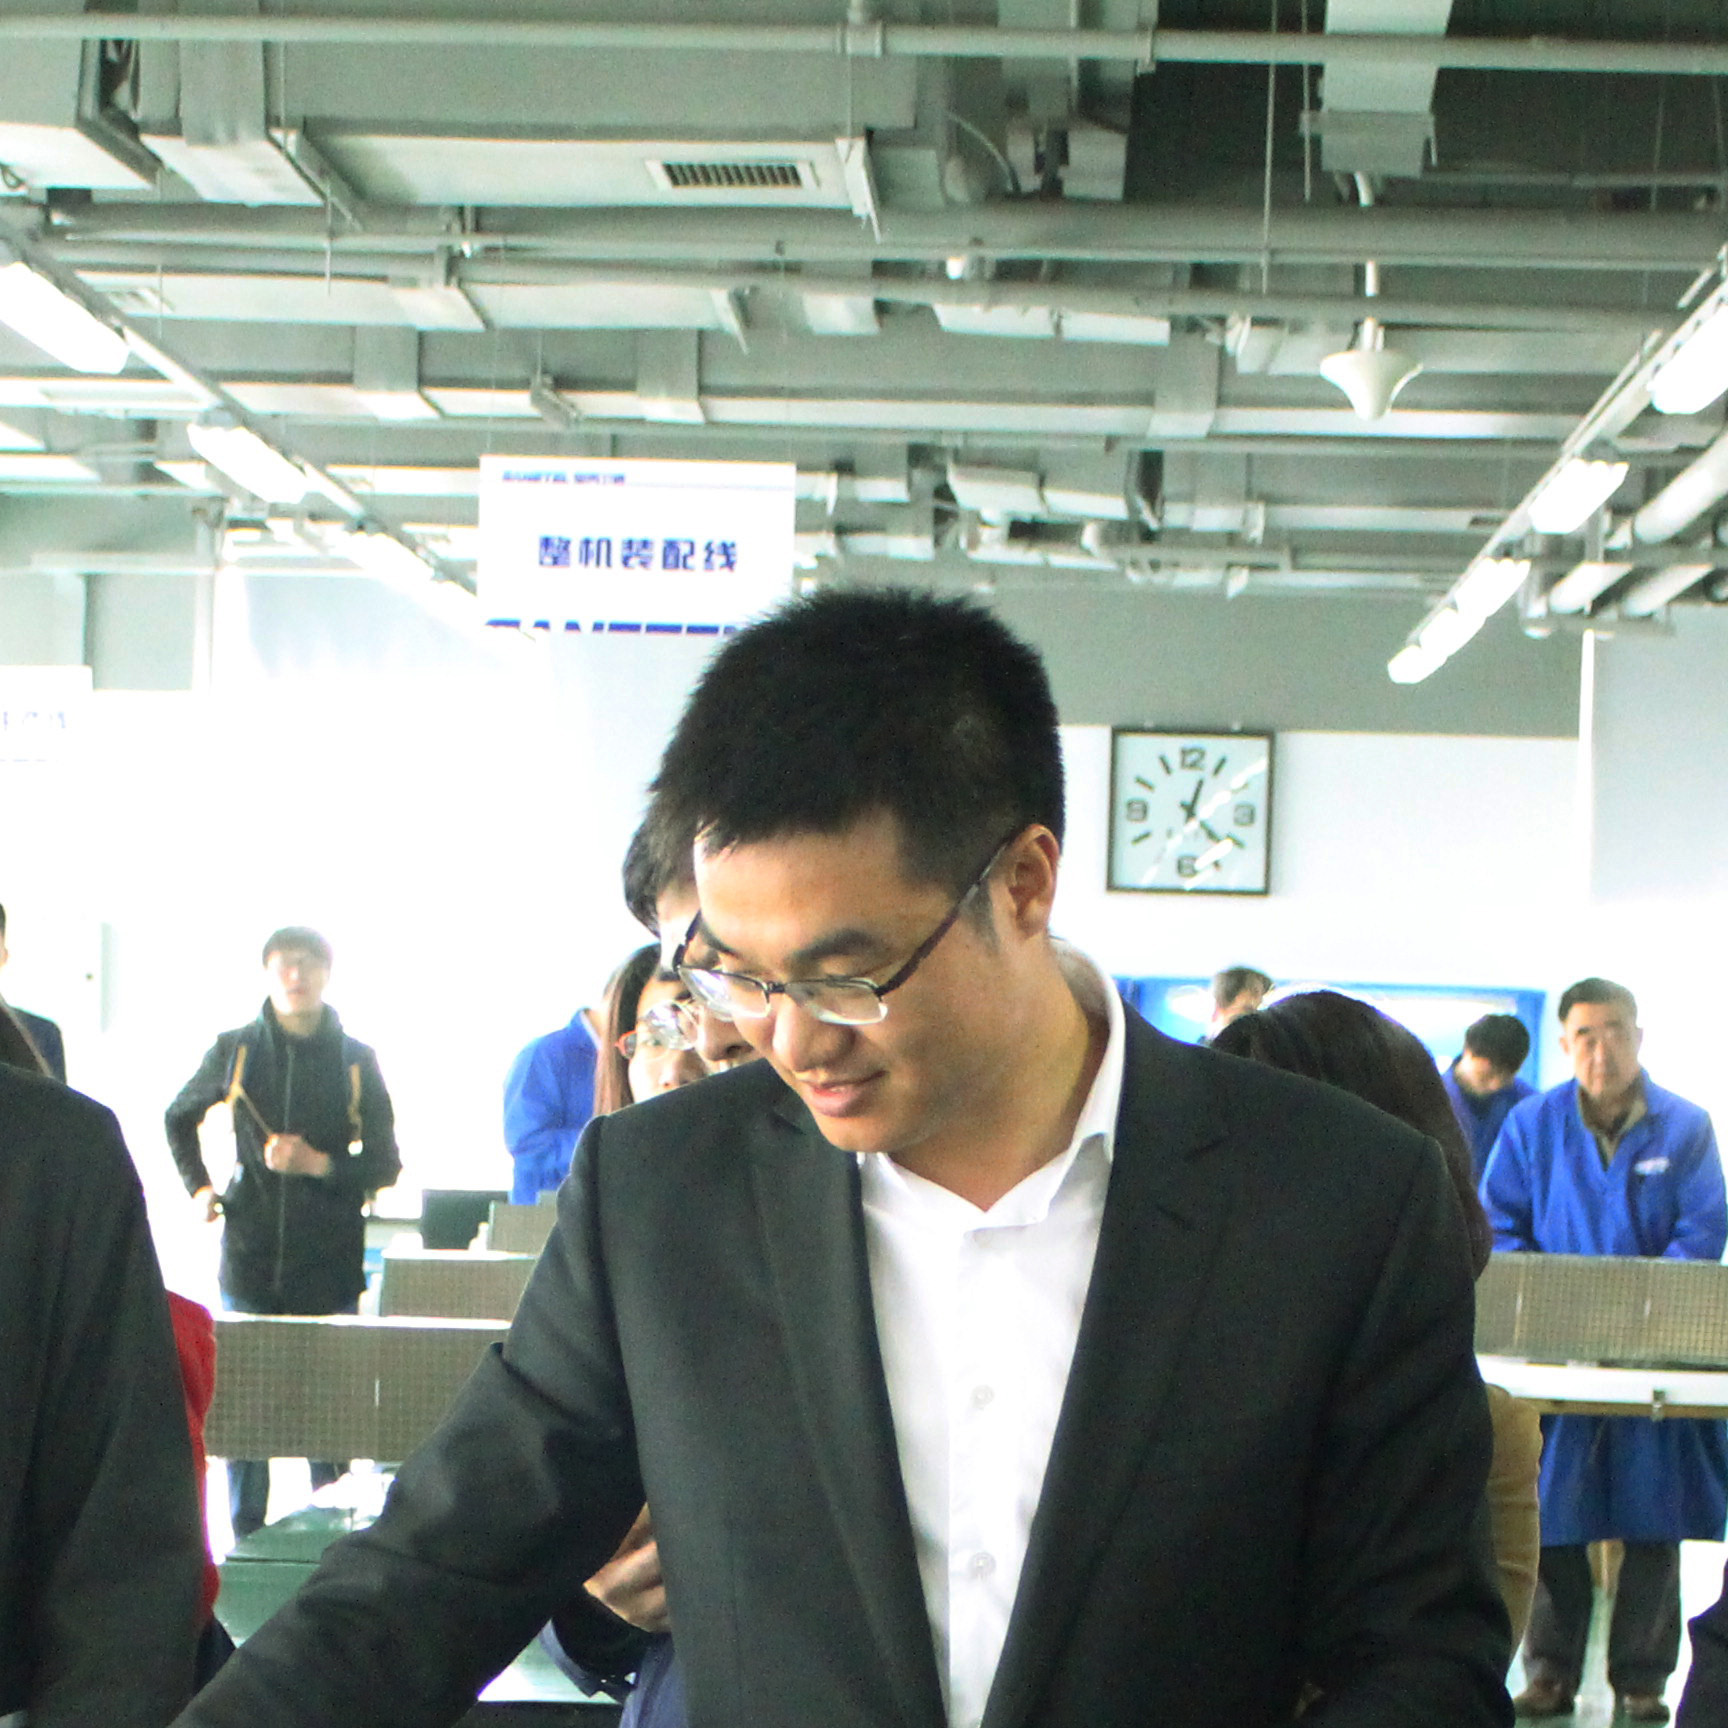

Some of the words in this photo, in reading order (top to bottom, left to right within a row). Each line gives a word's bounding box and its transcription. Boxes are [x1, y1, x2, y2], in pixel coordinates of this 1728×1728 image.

[538, 535, 738, 572] 整机装配线
[1180, 747, 1206, 771] 12
